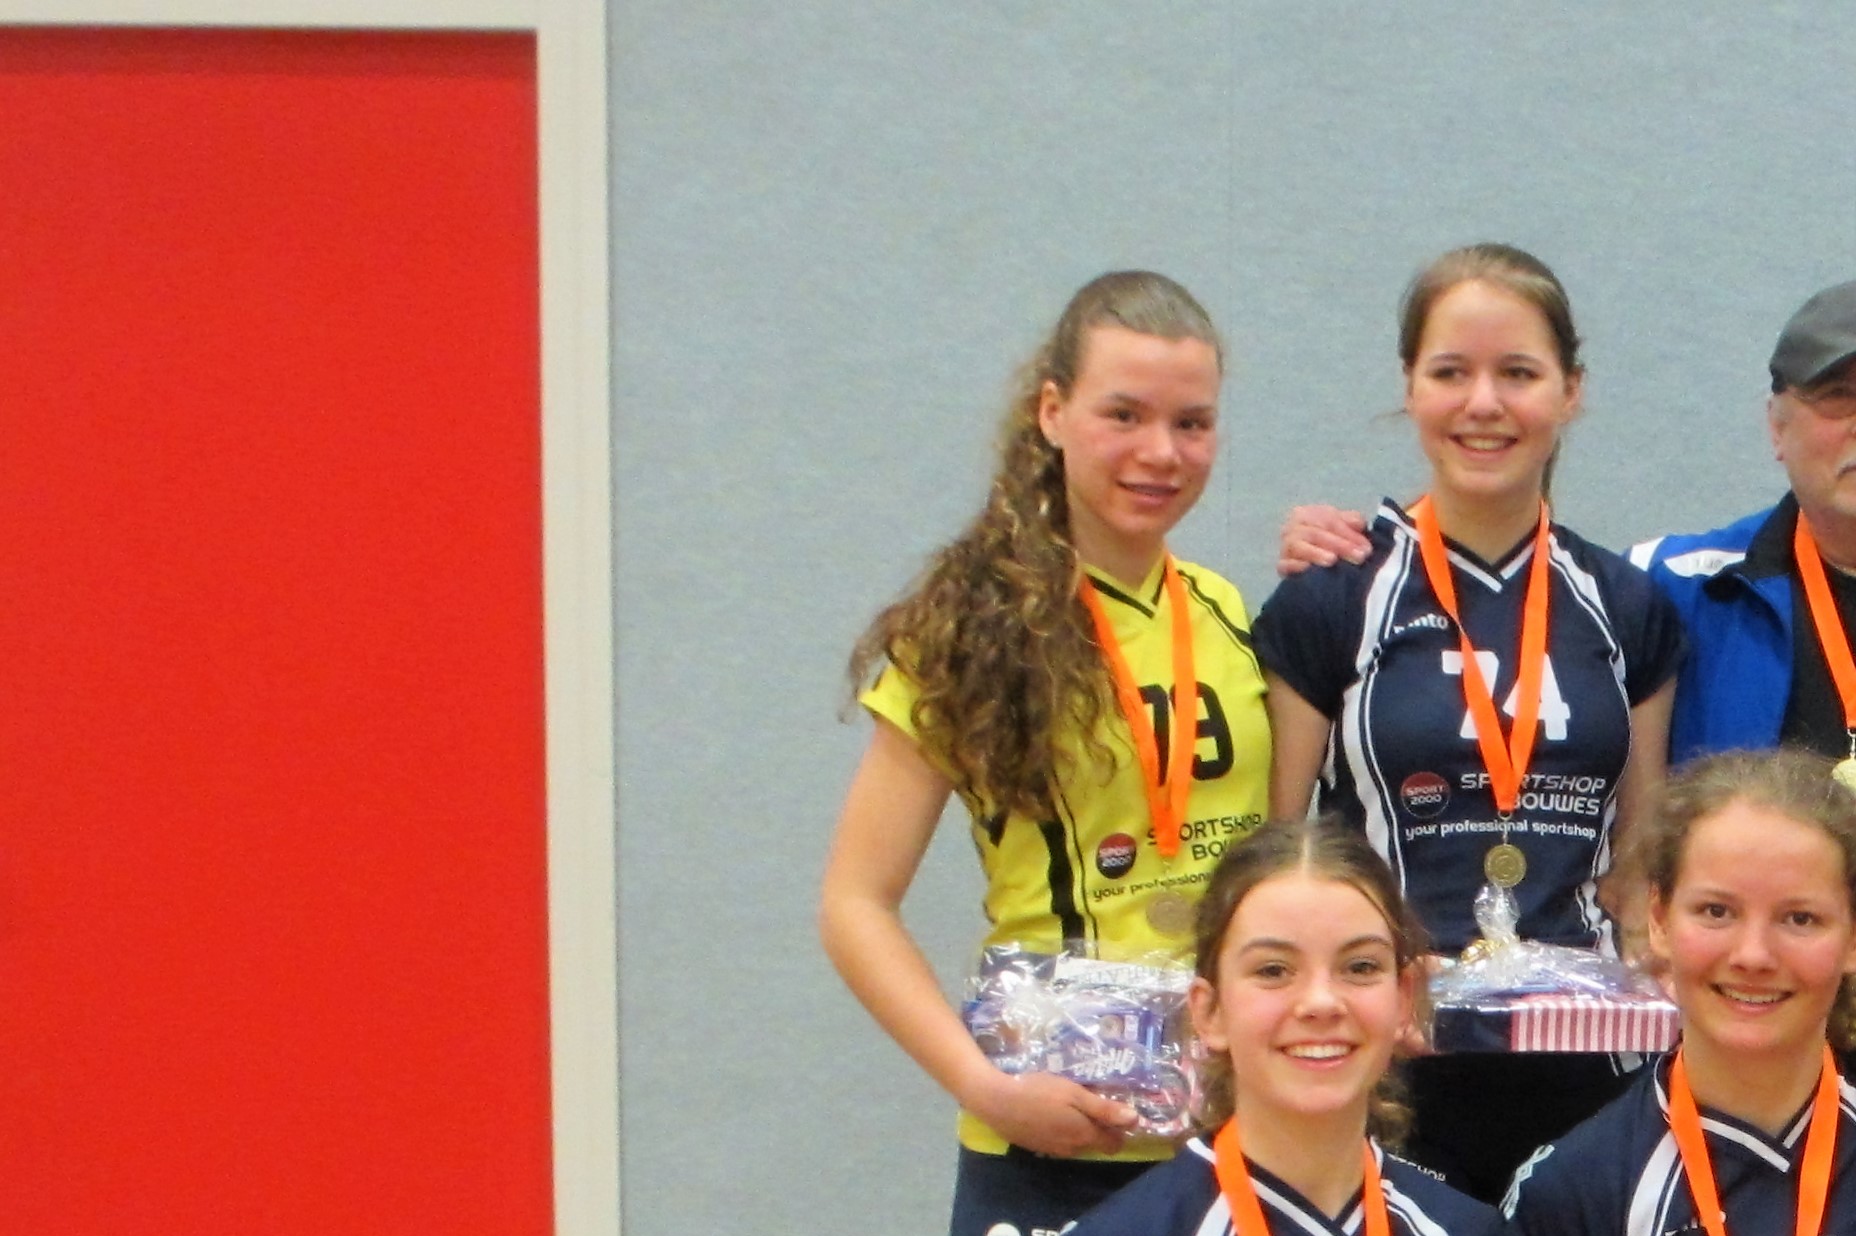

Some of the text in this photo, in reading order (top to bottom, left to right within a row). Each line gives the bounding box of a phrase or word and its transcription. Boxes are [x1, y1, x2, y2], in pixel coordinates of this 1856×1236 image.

[1441, 650, 1572, 740] 74
[1404, 818, 1597, 841] your professional sportshop
[1093, 886, 1125, 902] your
